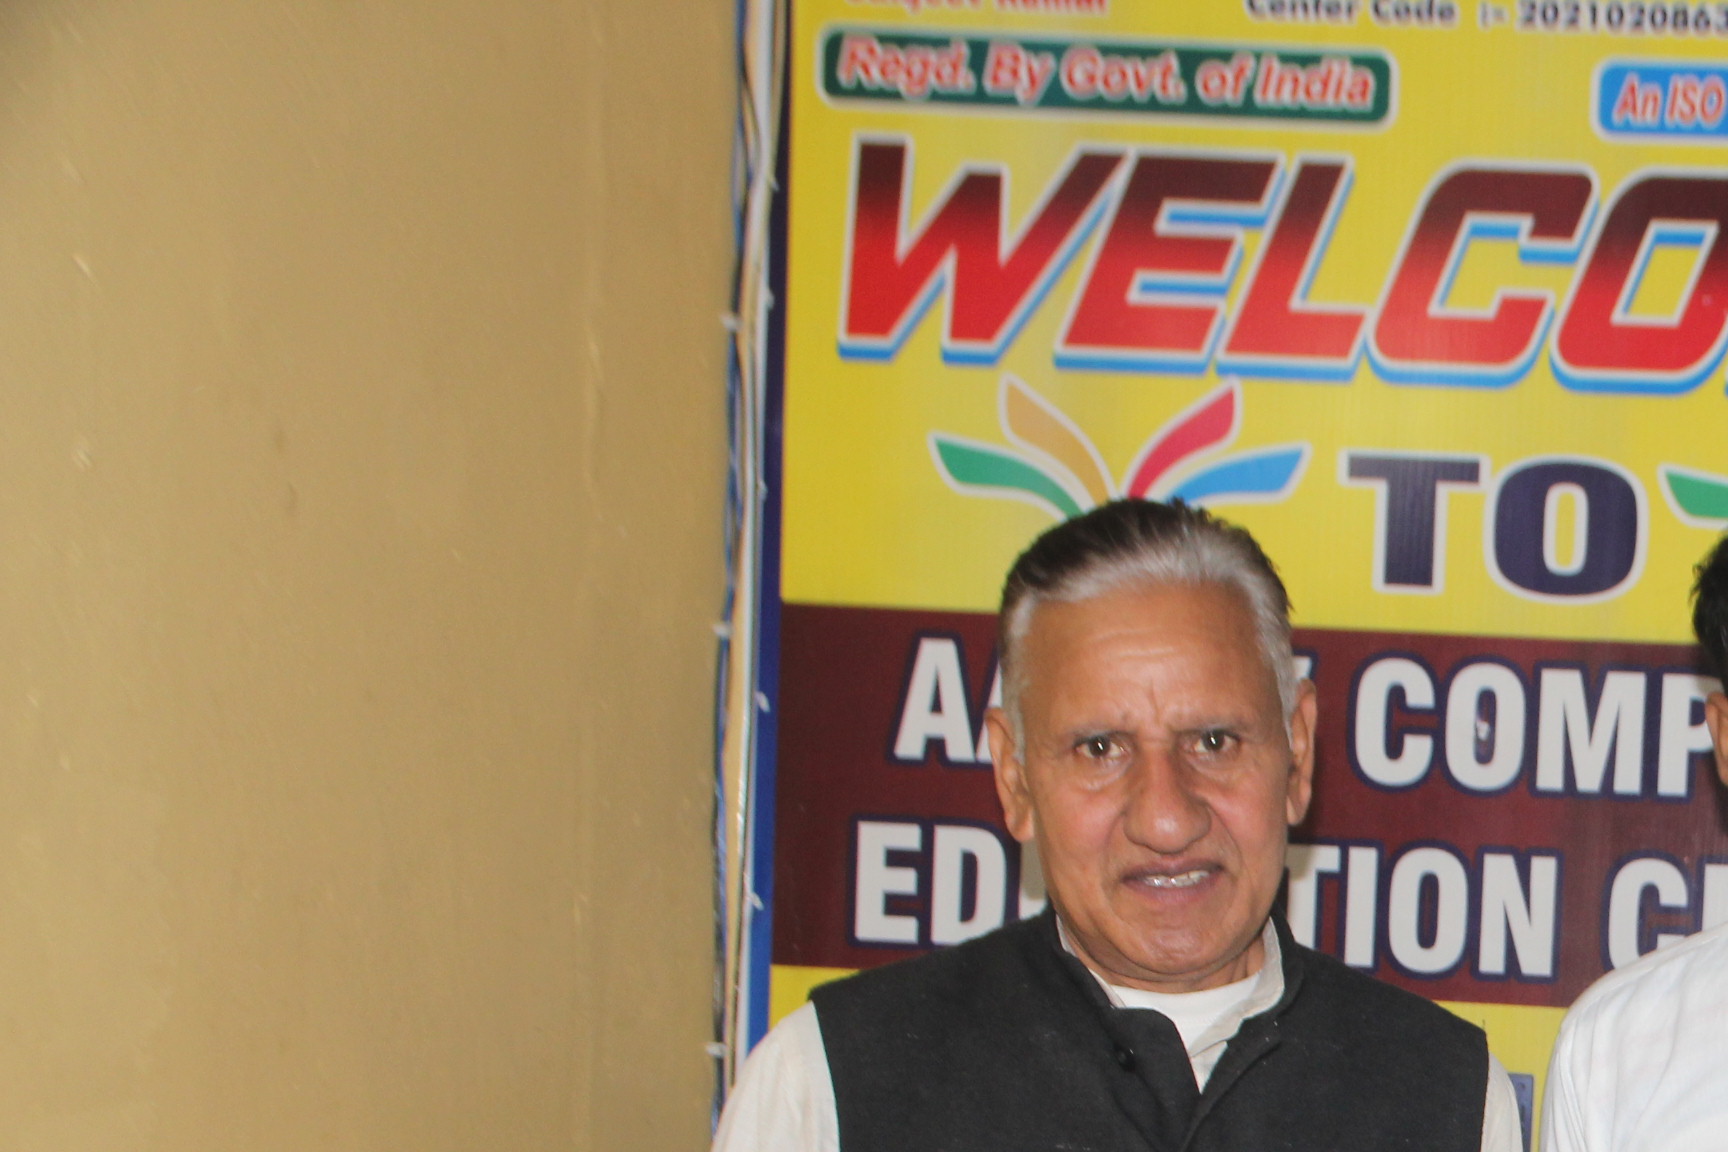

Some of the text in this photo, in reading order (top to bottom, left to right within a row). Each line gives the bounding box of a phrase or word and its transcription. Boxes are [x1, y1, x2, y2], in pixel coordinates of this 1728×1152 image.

[838, 34, 1375, 112] Regd. By Govt. of India
[1613, 71, 1663, 124] An
[1665, 74, 1726, 128] ISO
[1344, 450, 1648, 603] TO
